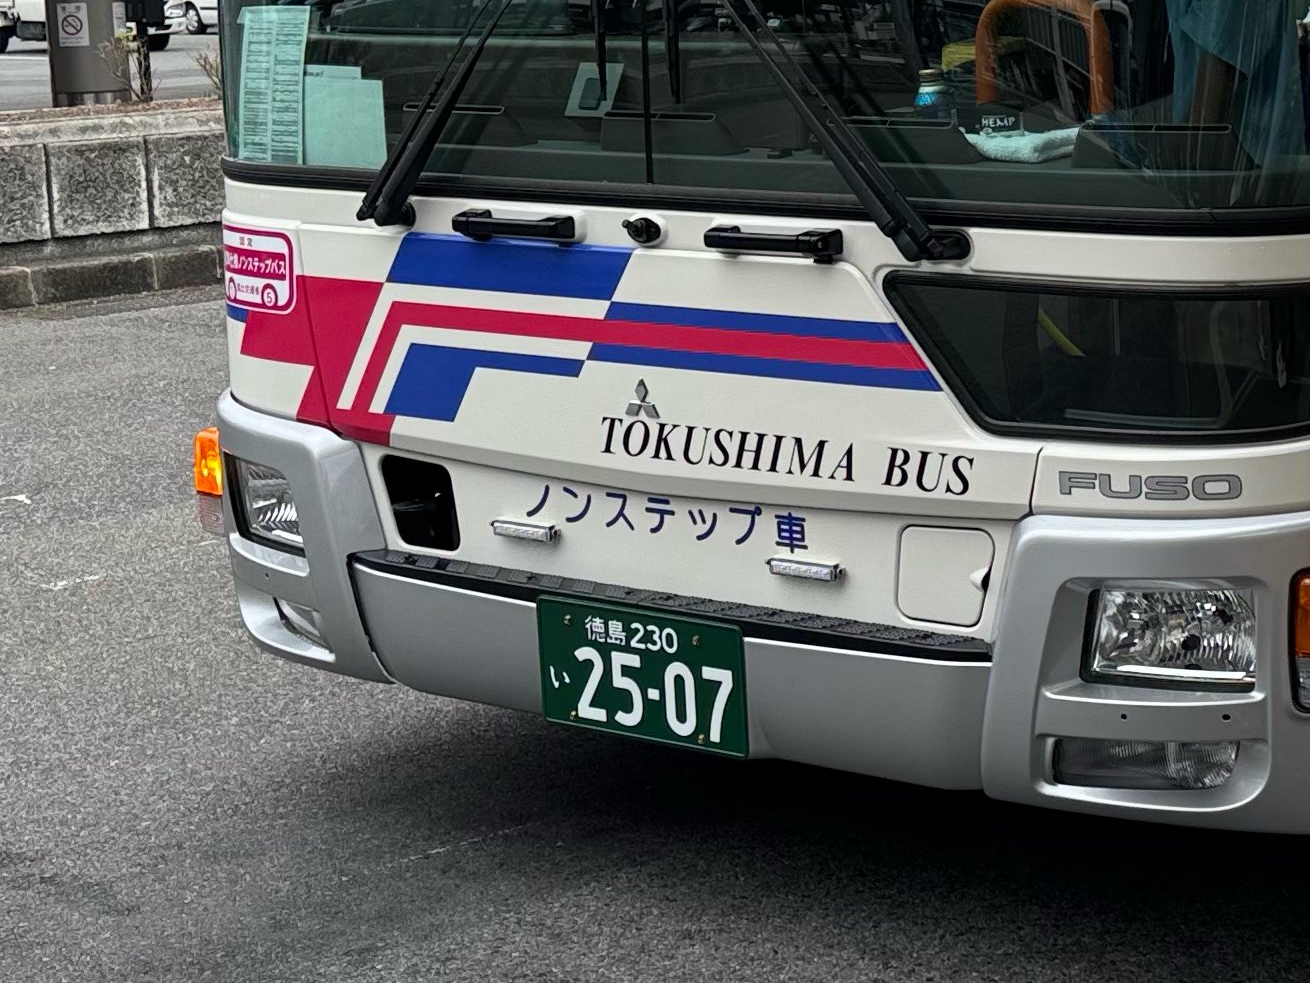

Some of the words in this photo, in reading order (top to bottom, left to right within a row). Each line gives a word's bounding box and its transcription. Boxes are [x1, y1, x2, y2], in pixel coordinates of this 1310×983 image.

[600, 417, 856, 482] TOKUSHIMA
[881, 446, 975, 495] BUS
[1058, 471, 1243, 500] FUSO
[526, 484, 808, 554] ノンステップ車
[549, 665, 571, 689] い
[573, 646, 734, 743] 25-07
